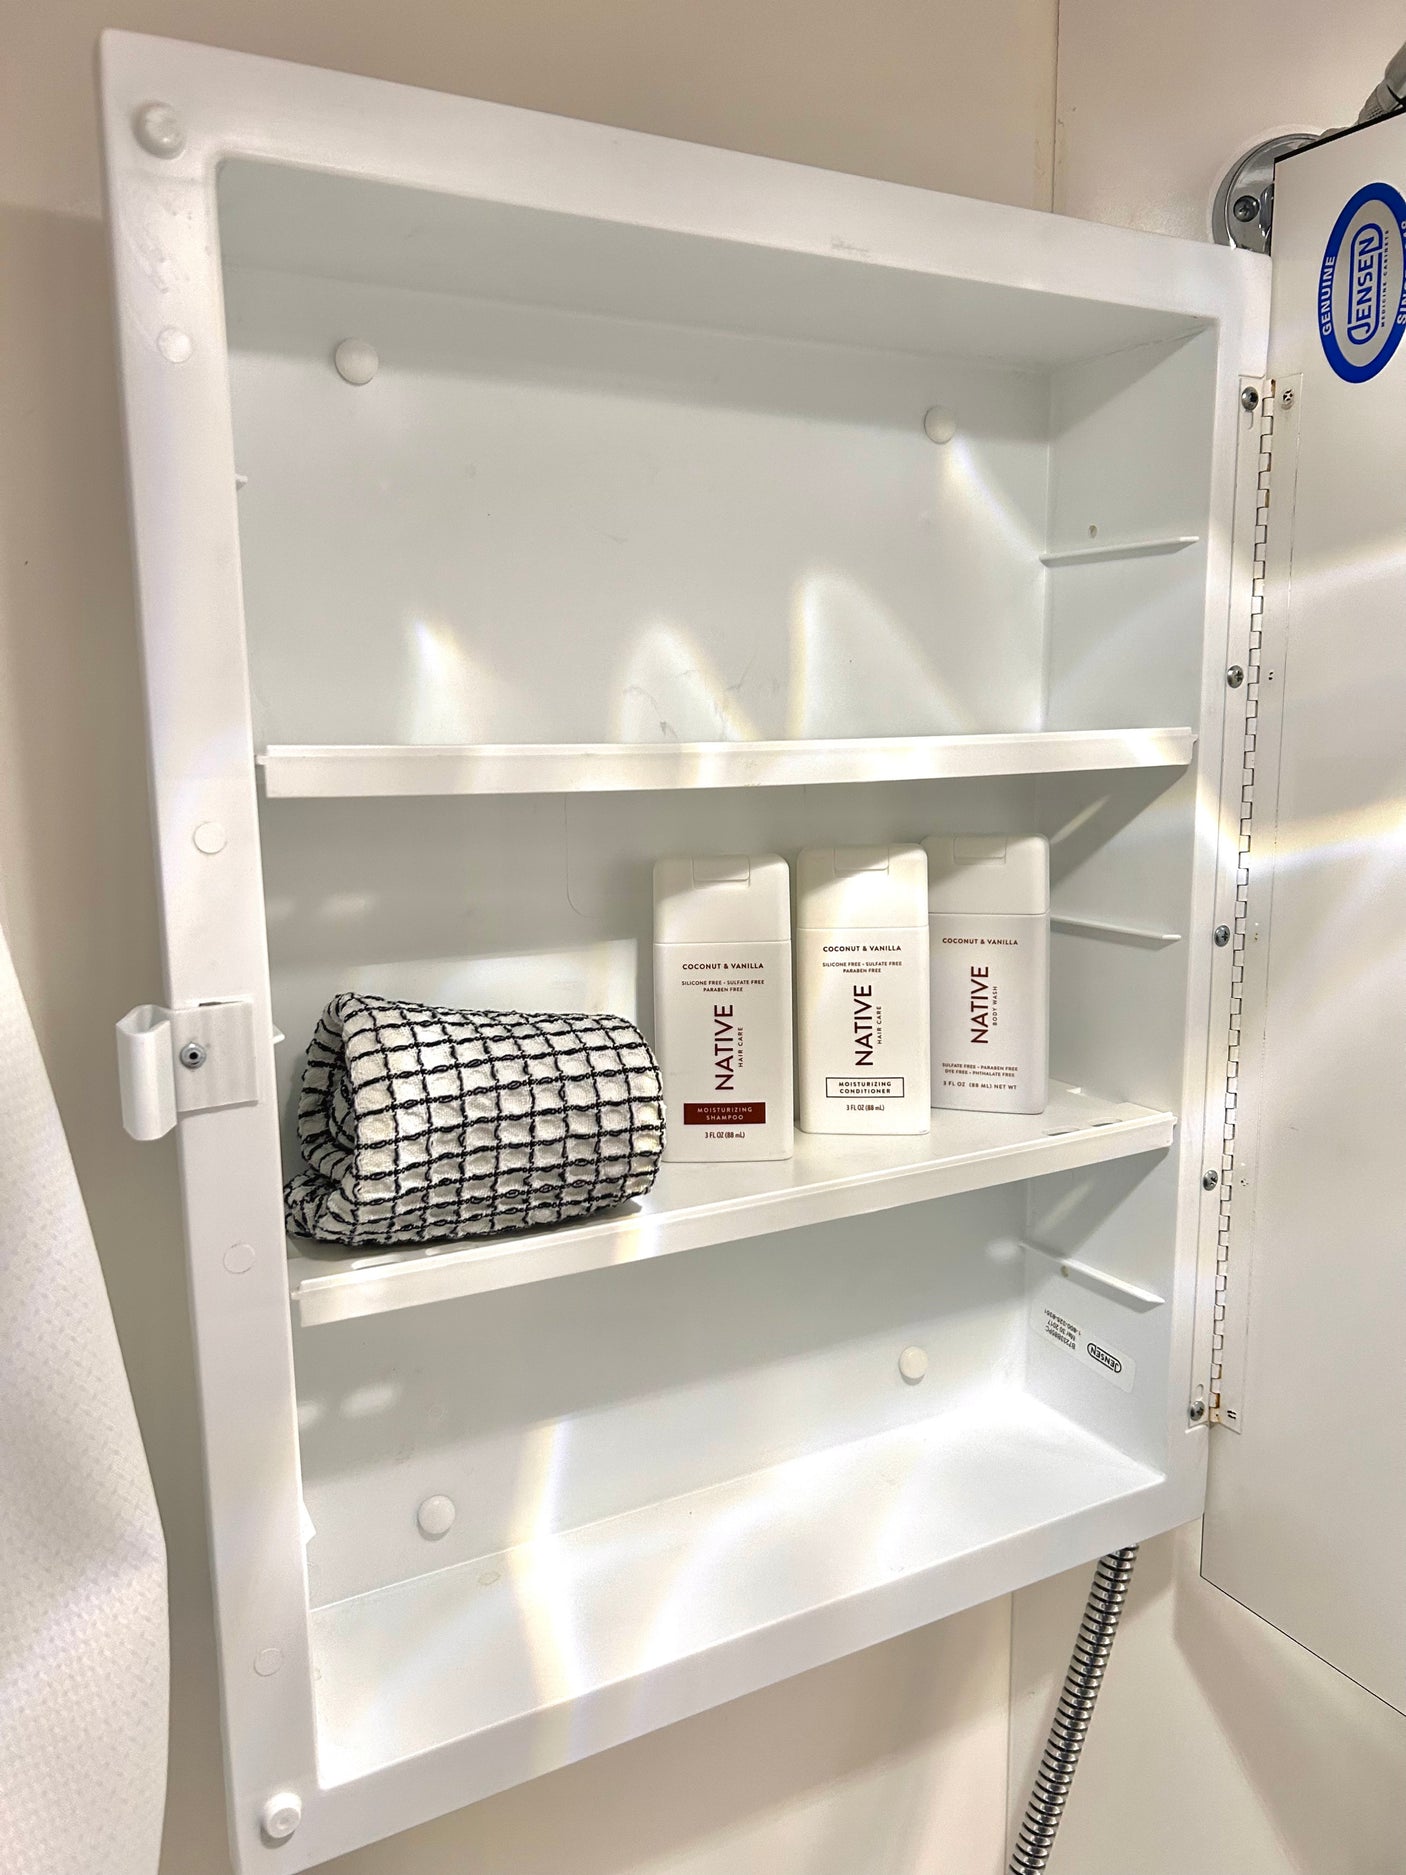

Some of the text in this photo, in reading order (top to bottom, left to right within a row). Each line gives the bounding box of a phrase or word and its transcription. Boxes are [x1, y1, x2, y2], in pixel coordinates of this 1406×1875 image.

[1321, 256, 1336, 336] GENUINE
[1348, 232, 1382, 340] JENSEN
[942, 937, 979, 945] COCONUT
[853, 984, 874, 1066] NATIVE
[970, 966, 989, 1044] NATIVE
[714, 1004, 734, 1090] NATIVE
[1089, 1345, 1120, 1371] JENSEN
